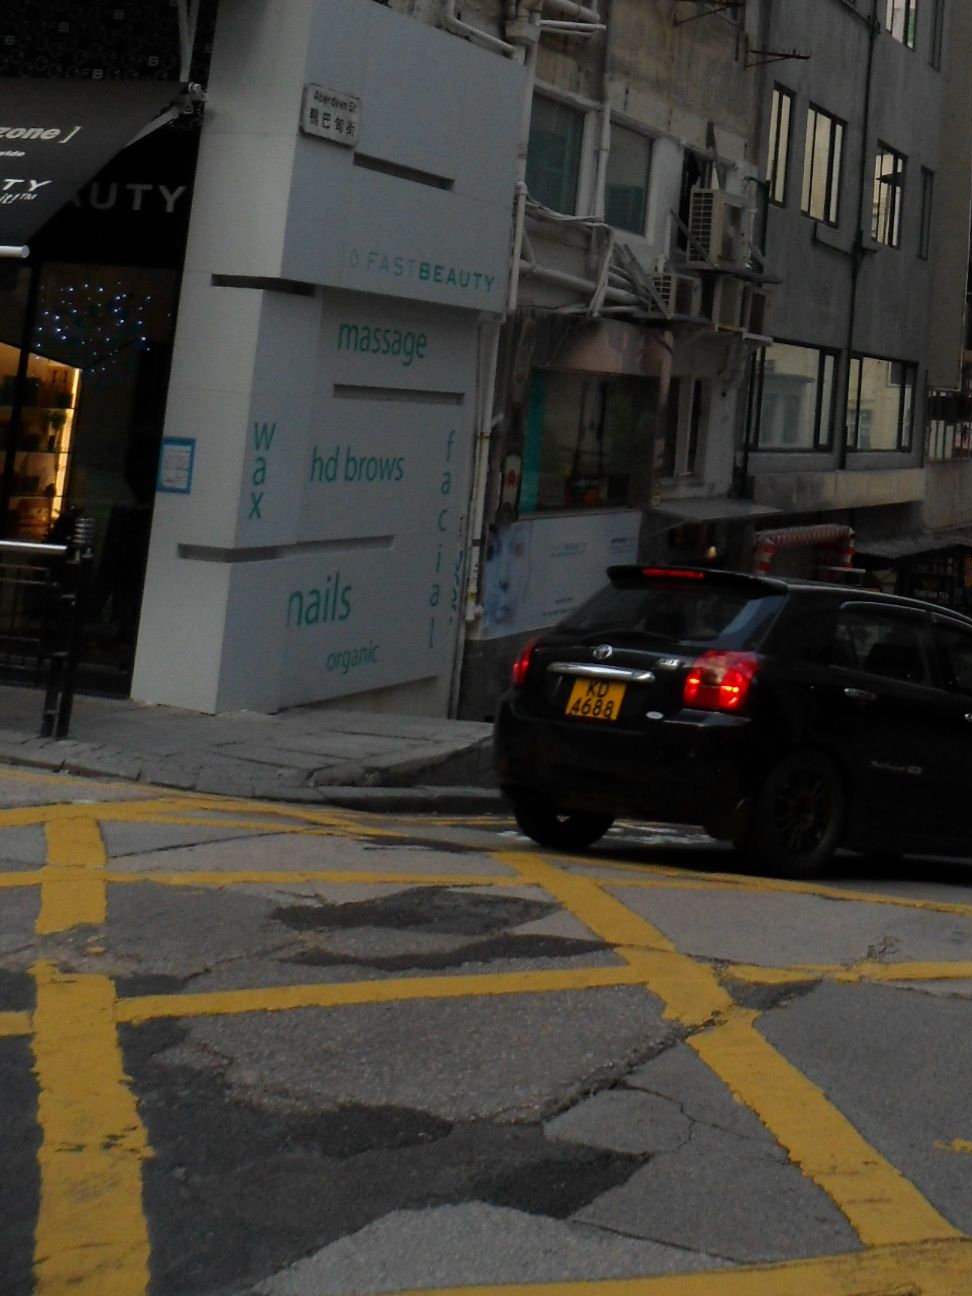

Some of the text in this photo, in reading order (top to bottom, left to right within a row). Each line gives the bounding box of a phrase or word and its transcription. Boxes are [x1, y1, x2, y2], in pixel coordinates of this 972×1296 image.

[313, 90, 348, 111] Aberdeen
[338, 322, 427, 366] massage
[309, 445, 405, 483] hd brows
[429, 430, 456, 649] facial
[286, 572, 353, 626] nails
[327, 641, 380, 674] organic
[572, 697, 614, 716] 4688
